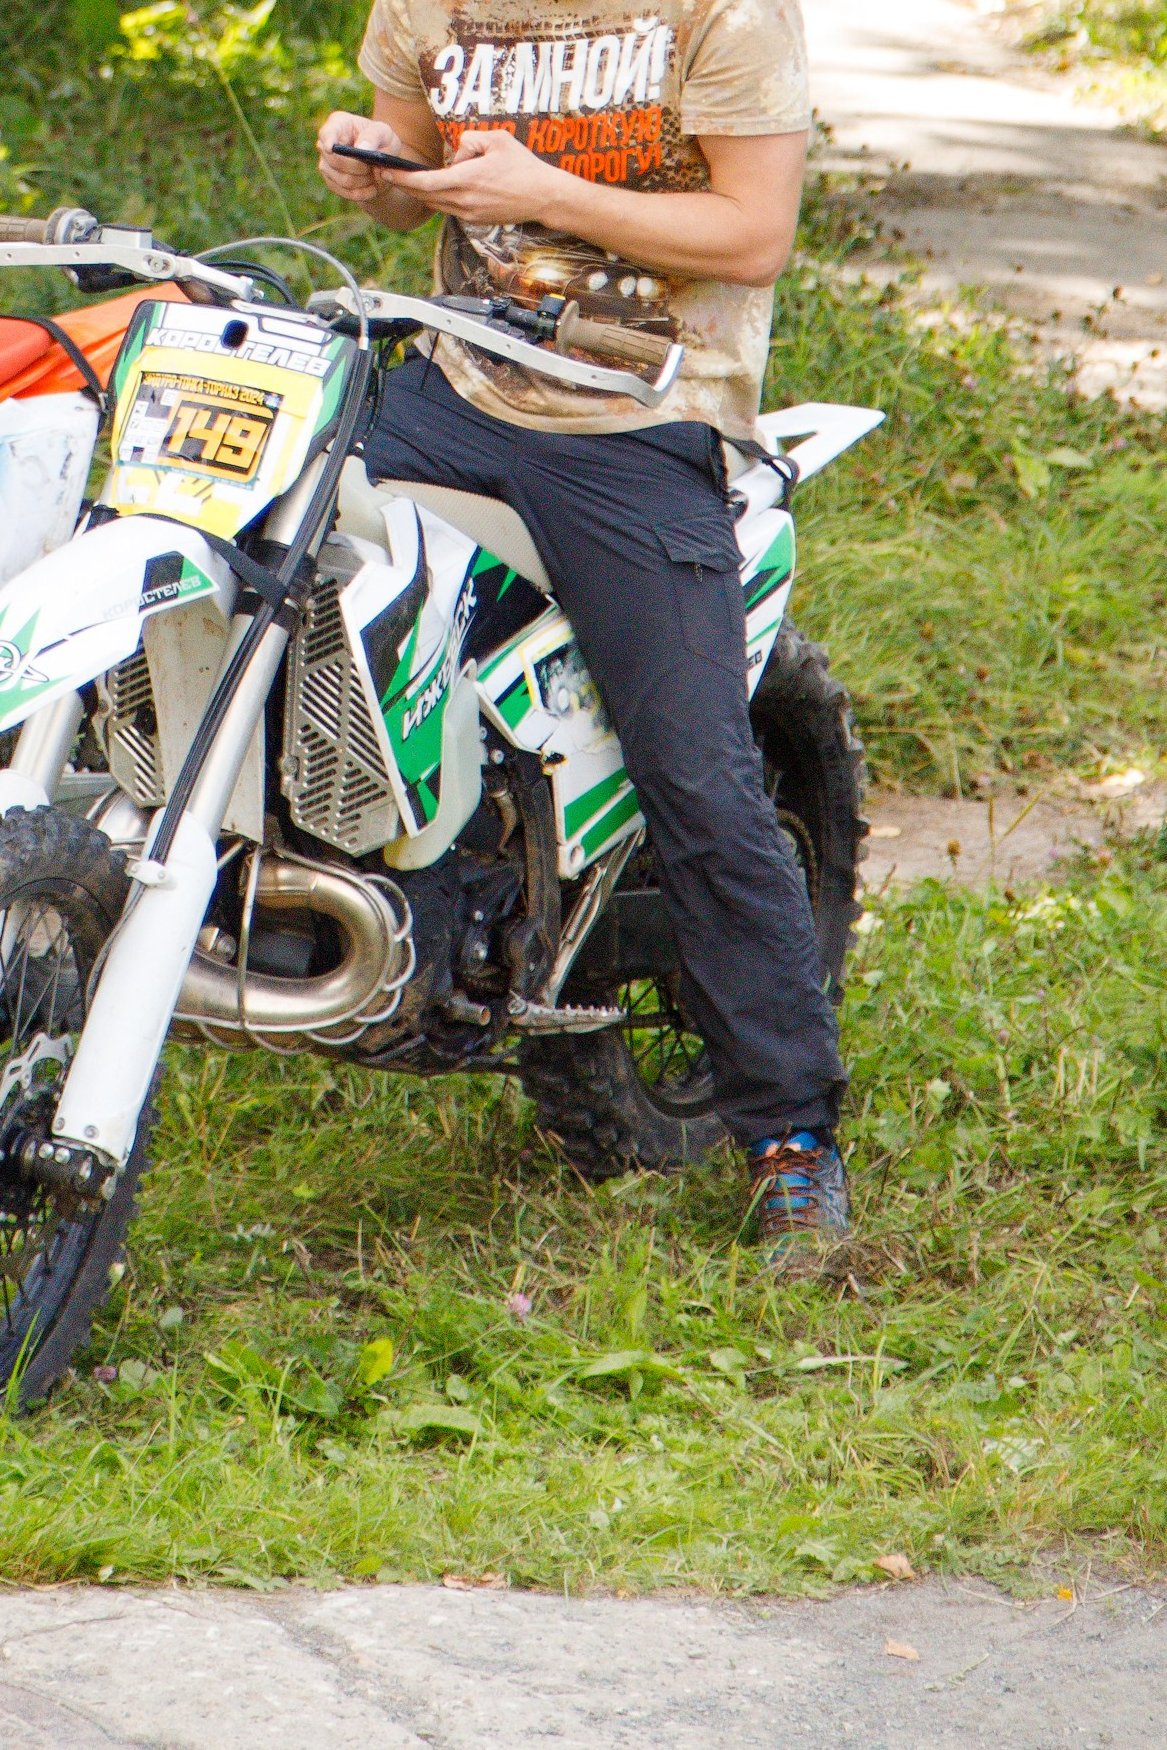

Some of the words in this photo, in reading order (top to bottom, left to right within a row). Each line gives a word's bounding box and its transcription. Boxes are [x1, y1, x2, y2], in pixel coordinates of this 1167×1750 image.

[430, 44, 494, 116] ЗА
[504, 15, 672, 113] МНОЙ!
[526, 105, 663, 154] КОРОТКУЮ
[145, 327, 333, 378] КОРОТЕЛЕВ
[239, 386, 266, 407] 2024
[166, 405, 269, 470] 149
